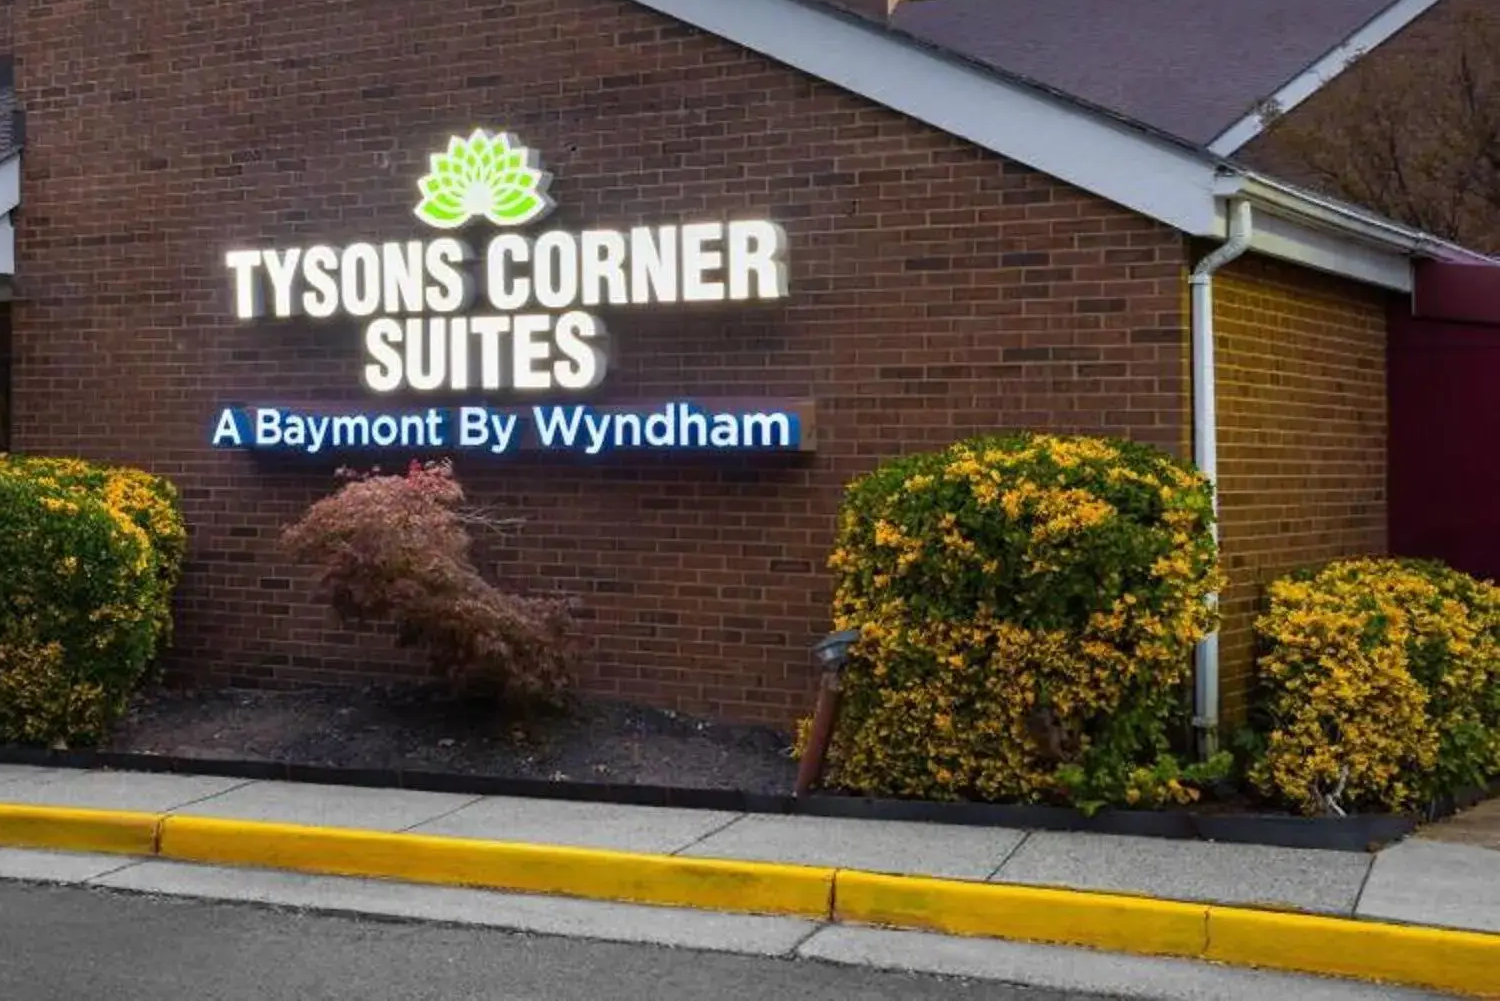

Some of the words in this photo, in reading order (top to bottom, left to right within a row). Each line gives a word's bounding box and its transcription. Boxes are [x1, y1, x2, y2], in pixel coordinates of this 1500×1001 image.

[226, 237, 465, 319] TYSONS
[487, 220, 785, 310] CORNER
[364, 311, 598, 392] SUITES
[212, 412, 242, 446] A
[255, 406, 443, 454] Baymont
[459, 406, 518, 454] By
[533, 402, 791, 455] Wyndham
